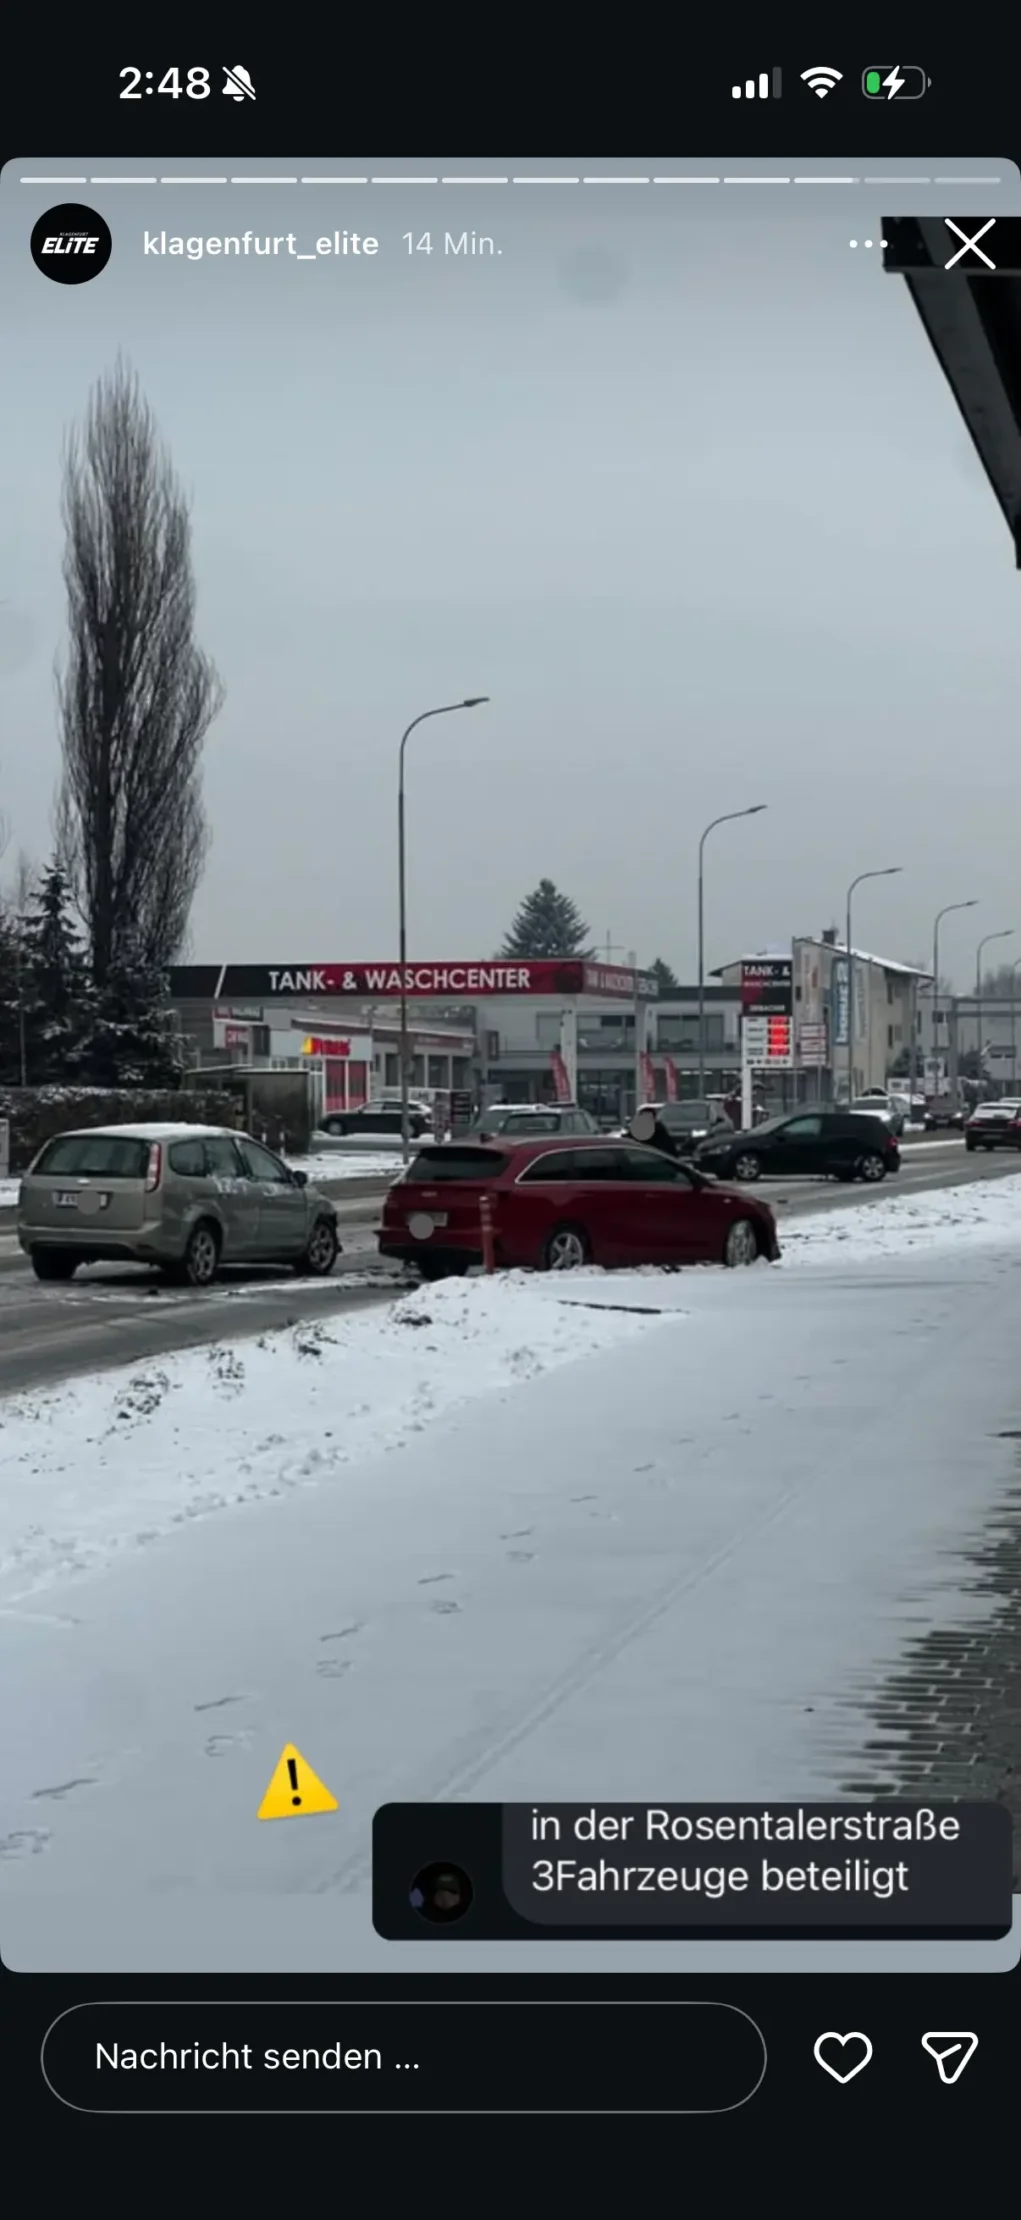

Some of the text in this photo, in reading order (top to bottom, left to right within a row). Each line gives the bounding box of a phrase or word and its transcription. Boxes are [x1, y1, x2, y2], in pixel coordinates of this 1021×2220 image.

[268, 968, 531, 990] TANK- & WASCHCENTER
[743, 965, 780, 977] TANK-
